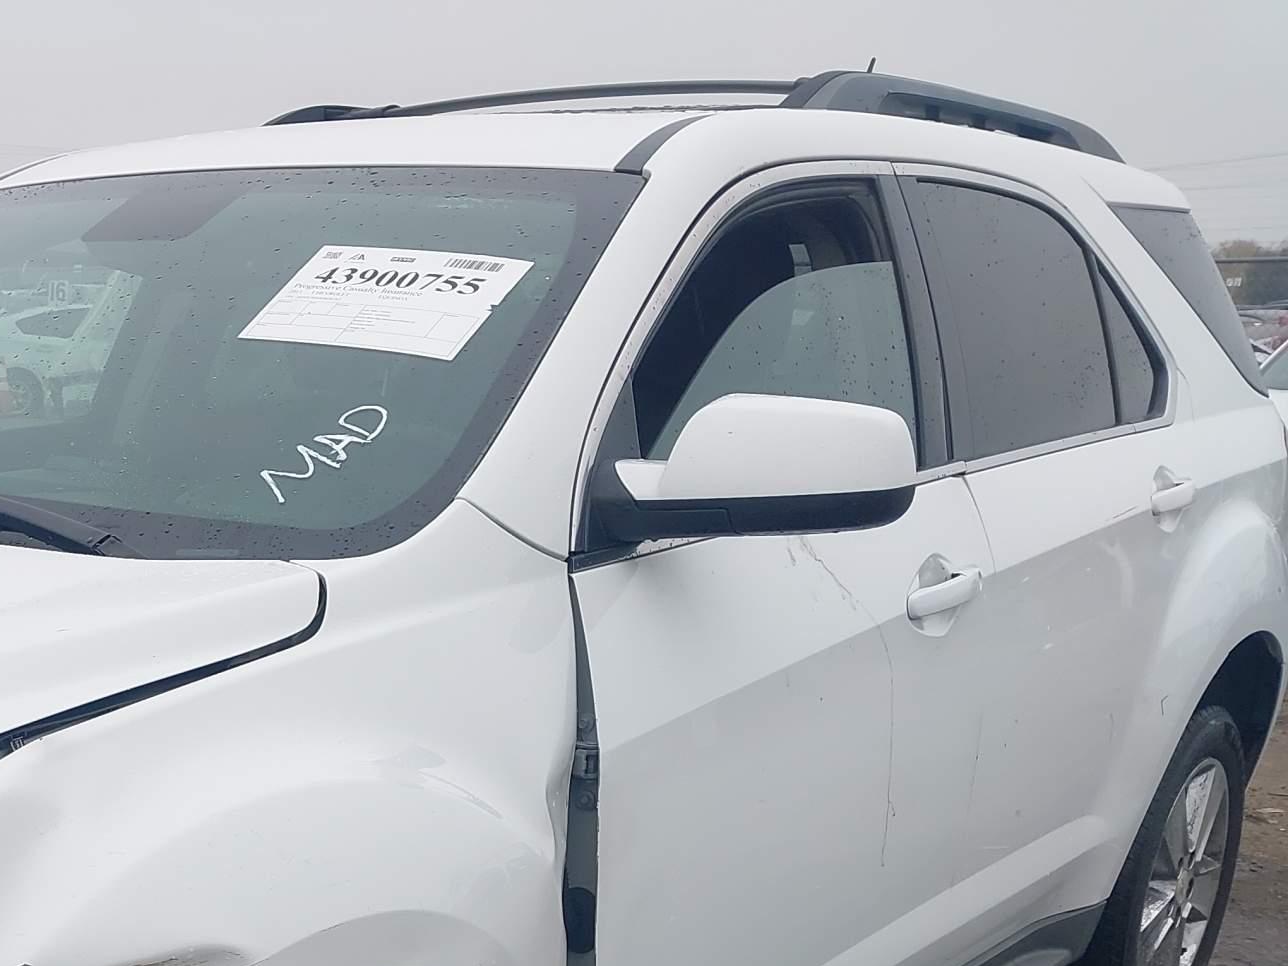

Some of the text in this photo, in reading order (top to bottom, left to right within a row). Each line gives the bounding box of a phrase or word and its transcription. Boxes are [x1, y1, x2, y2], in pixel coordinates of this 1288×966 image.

[50, 282, 66, 302] 16
[314, 267, 487, 295] 43900755
[261, 405, 388, 503] MAD
